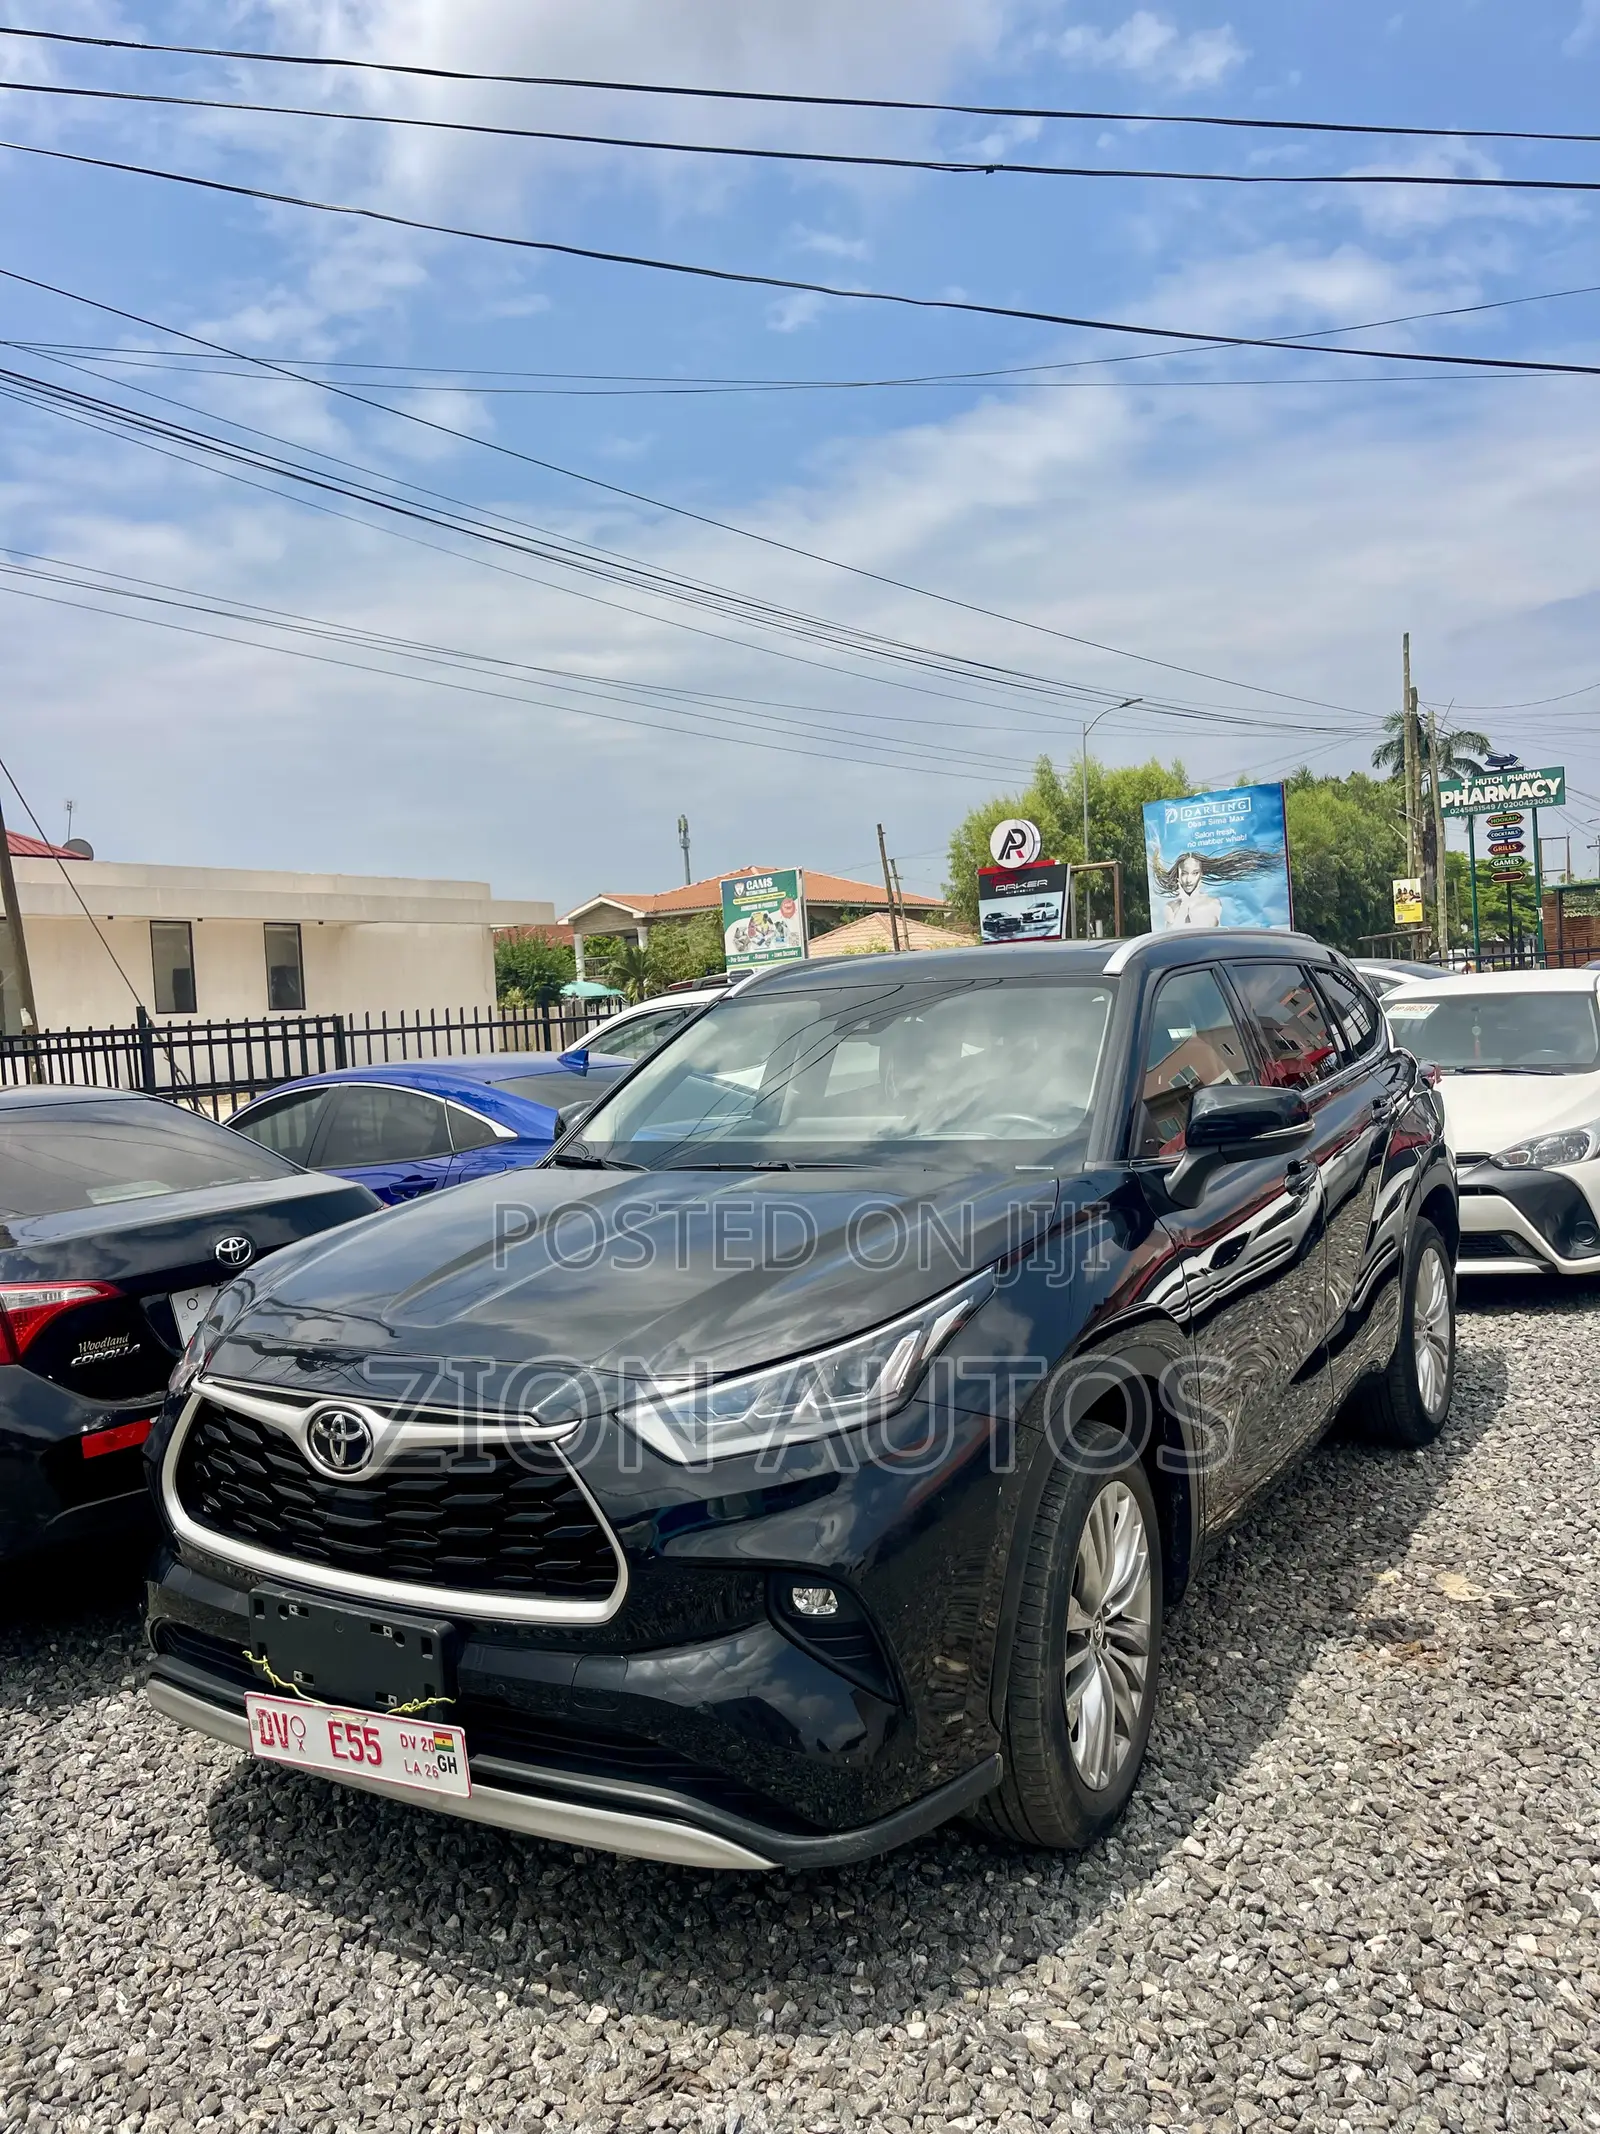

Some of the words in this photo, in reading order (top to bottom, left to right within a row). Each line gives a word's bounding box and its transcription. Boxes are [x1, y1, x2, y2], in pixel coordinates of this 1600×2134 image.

[1475, 776, 1502, 786] HUTCH
[1507, 771, 1541, 783] PHARMA
[1440, 778, 1561, 808] PHARMACY
[1185, 801, 1247, 816] DARLING
[1450, 803, 1496, 815] 0245851549
[1503, 797, 1554, 809] 0200423063
[1208, 816, 1228, 825] Sima
[1229, 814, 1245, 823] Max
[1491, 815, 1518, 824] HOOKAH
[1187, 840, 1197, 848] no
[1198, 837, 1224, 846] matter
[1226, 834, 1247, 842] what!
[1194, 830, 1215, 839] Salon
[1216, 828, 1237, 837] fresh,
[1491, 829, 1518, 838] COCKTAILS
[1493, 844, 1517, 852] GRILLS
[1493, 859, 1519, 867] GAMES
[746, 877, 773, 890] CAMS
[79, 1332, 129, 1353] Woodland
[256, 1707, 289, 1749] DV
[327, 1720, 382, 1766] E55
[400, 1732, 417, 1749] DV
[421, 1736, 435, 1753] 20
[404, 1758, 422, 1775] LA
[425, 1763, 438, 1779] 26
[437, 1754, 458, 1775] GH
